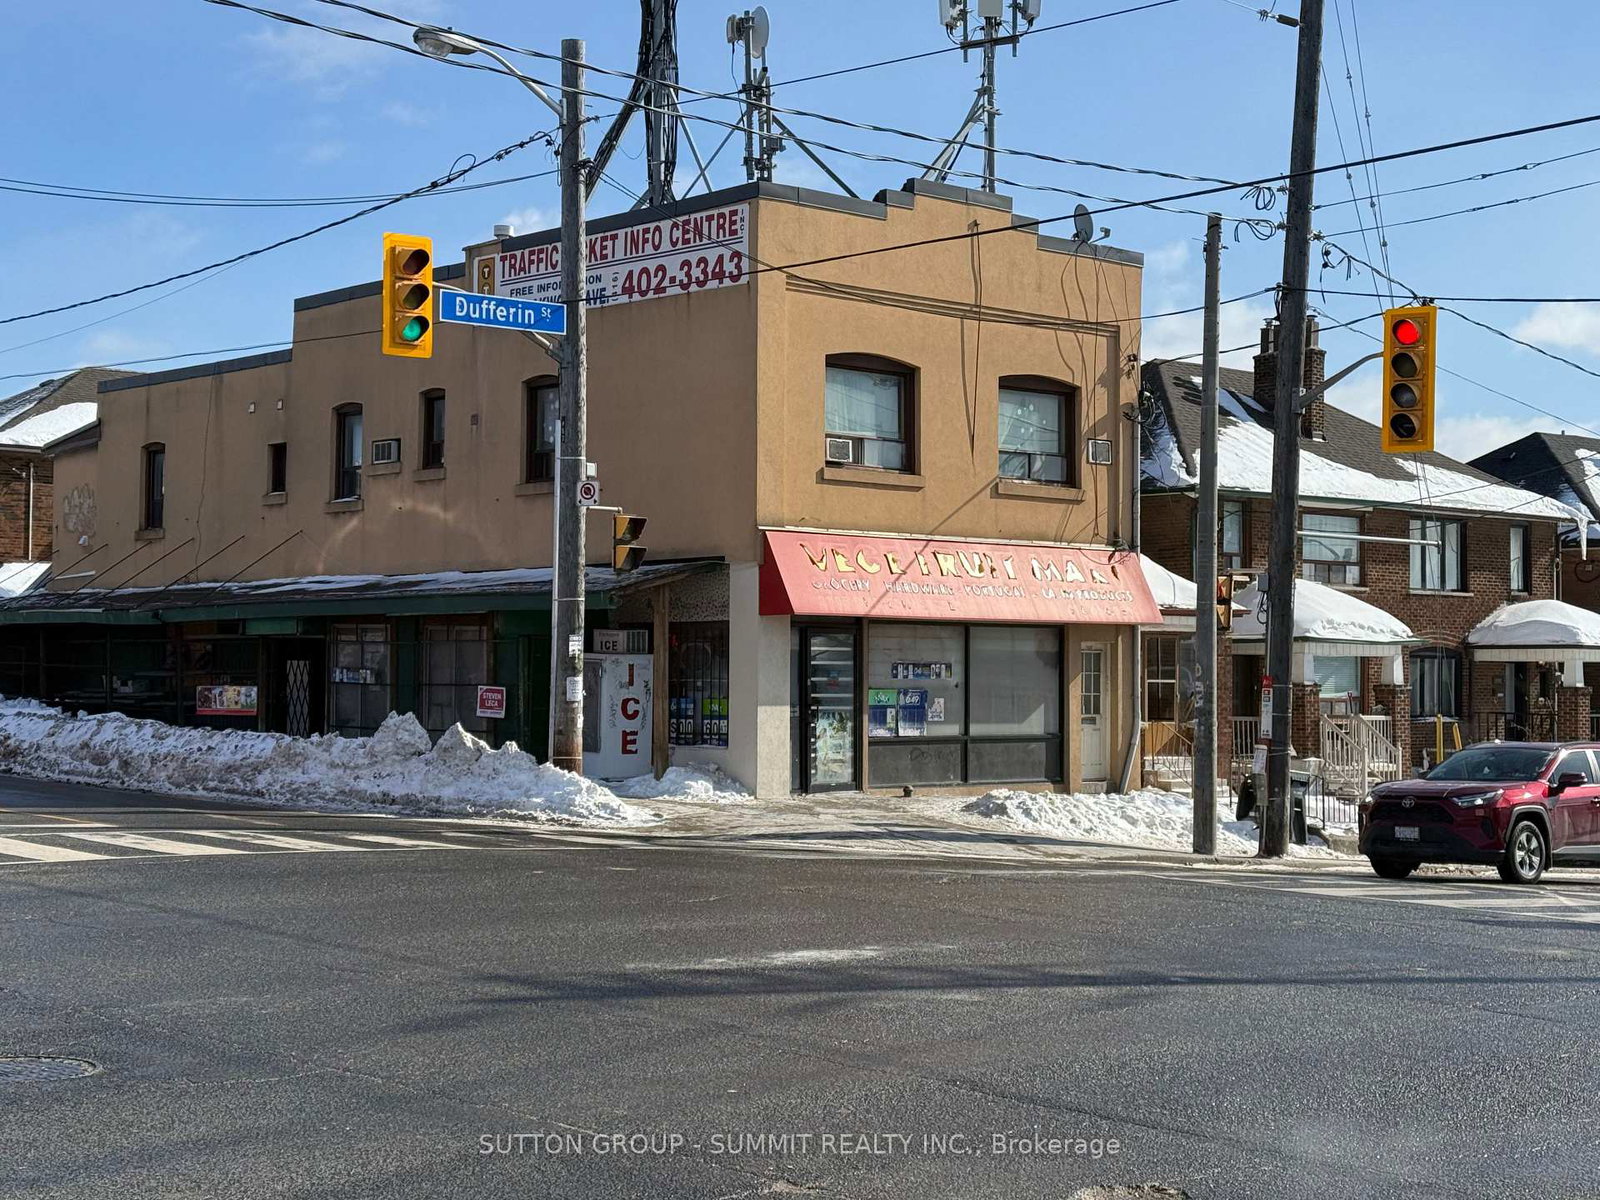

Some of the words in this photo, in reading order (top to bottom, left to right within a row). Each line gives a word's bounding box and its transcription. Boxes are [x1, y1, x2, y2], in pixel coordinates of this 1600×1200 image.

[500, 245, 559, 279] TRAFFIC
[585, 233, 618, 264] KET
[624, 224, 663, 257] INFO
[669, 208, 739, 248] CENTRE
[510, 285, 534, 298] FREE
[621, 251, 743, 300] 402-3343
[455, 296, 535, 325] Dufferin
[600, 640, 618, 651] ICE
[620, 663, 640, 755] ICE
